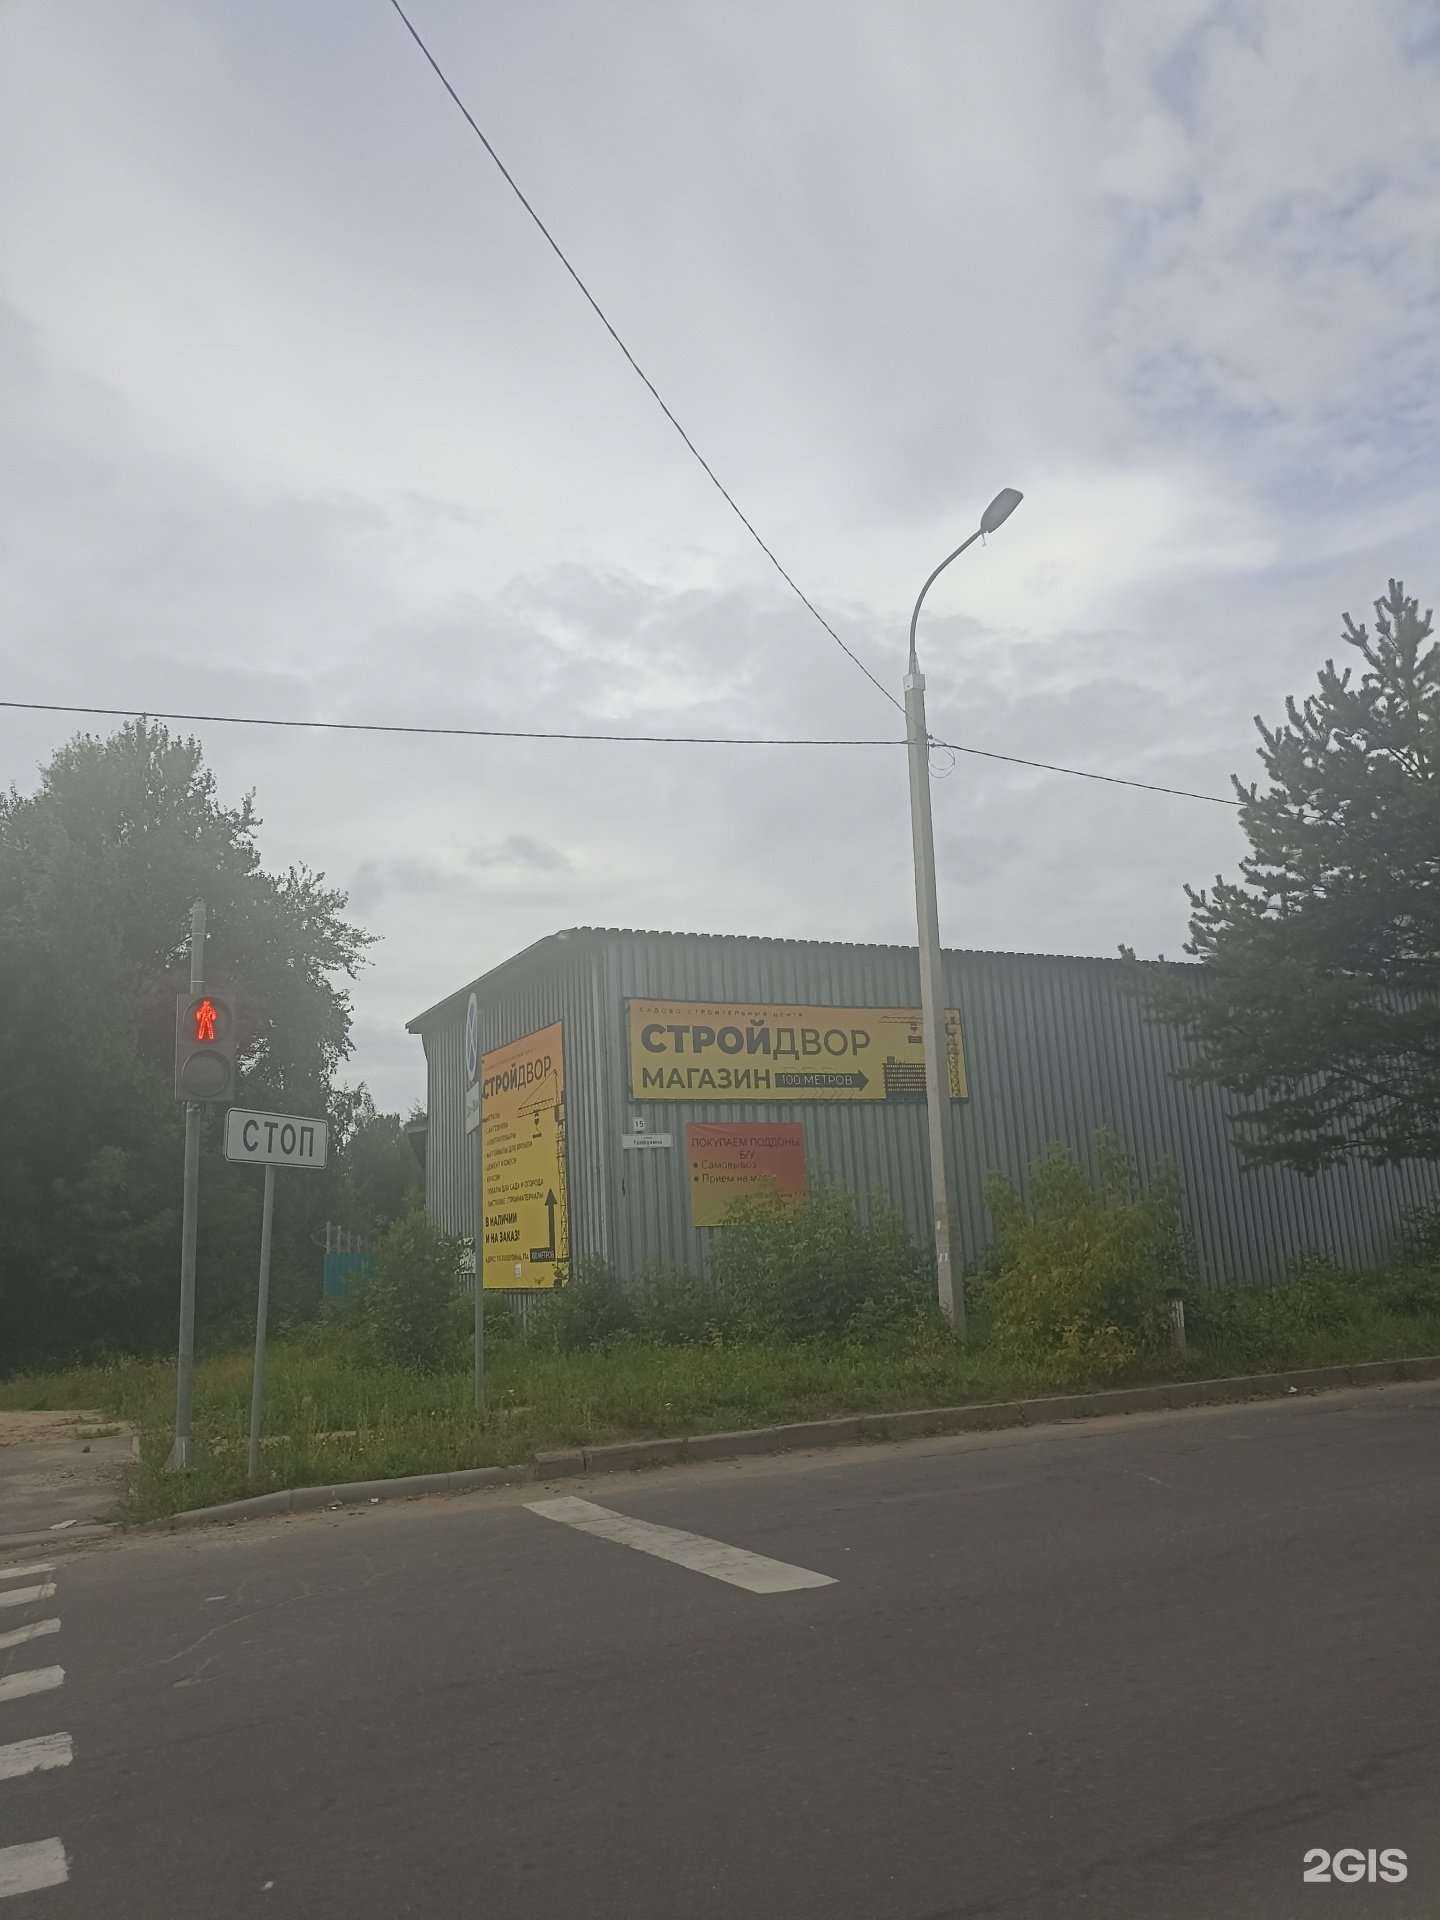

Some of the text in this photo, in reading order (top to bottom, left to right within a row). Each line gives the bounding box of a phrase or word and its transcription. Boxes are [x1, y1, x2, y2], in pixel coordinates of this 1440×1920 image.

[641, 1019, 871, 1061] СТРОЙДВОР
[482, 1055, 552, 1100] СТРОЙДВОР
[642, 1067, 771, 1089] МАГАЗИН
[783, 1074, 854, 1086] 100 МЕТРОВ
[242, 1119, 314, 1158] СТОП
[690, 1137, 746, 1148] ПОКУПАЕМ
[485, 1212, 518, 1227] В НАЛИЧИИ
[485, 1234, 490, 1243] И
[490, 1232, 499, 1243] НА
